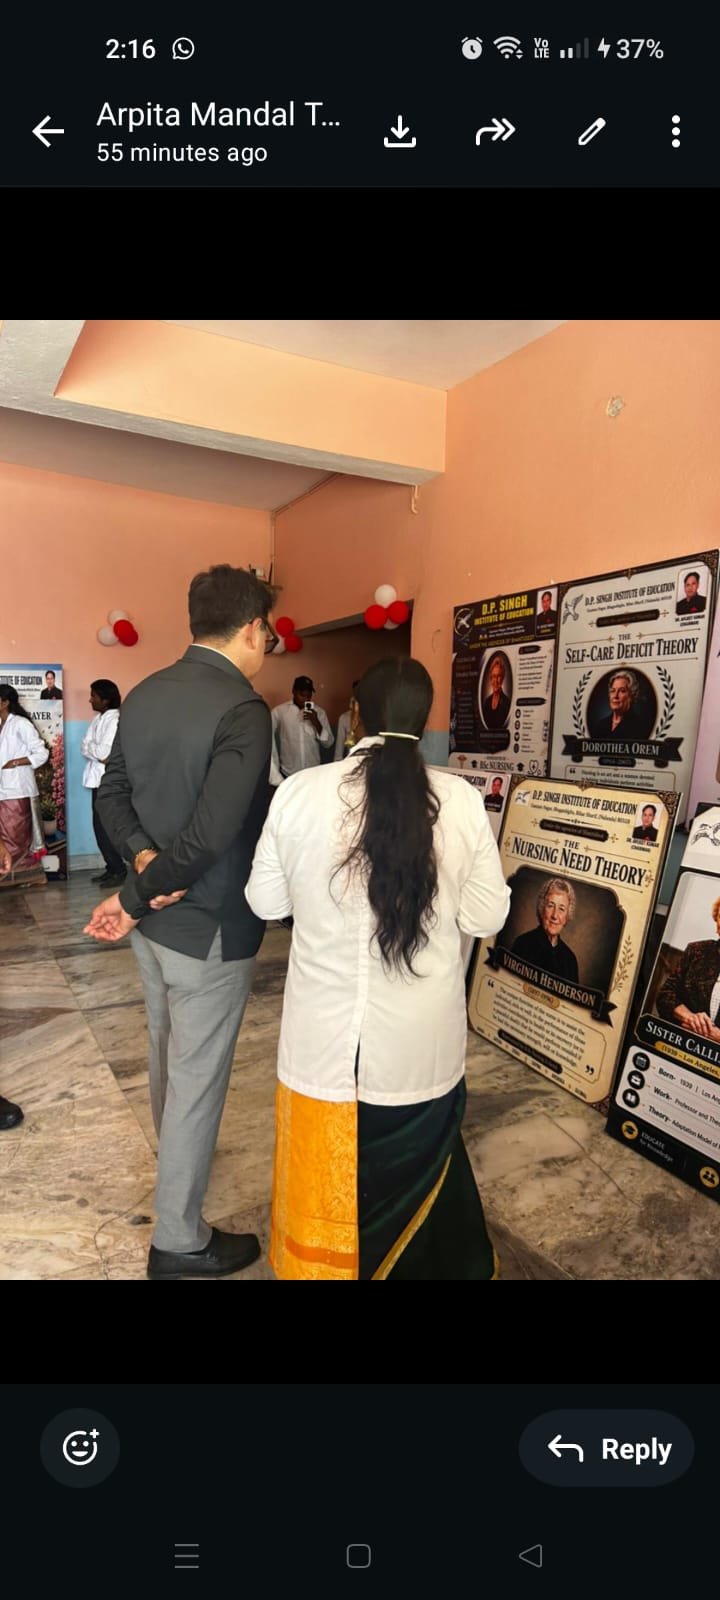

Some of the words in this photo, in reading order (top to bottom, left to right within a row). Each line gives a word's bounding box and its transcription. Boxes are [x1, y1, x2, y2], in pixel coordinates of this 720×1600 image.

[500, 594, 528, 612] SINGH
[613, 588, 638, 601] INSTITUTE
[639, 586, 647, 596] OF
[646, 582, 675, 595] EDUCATION
[618, 633, 631, 641] THE
[565, 645, 615, 664] SELF-CARE
[617, 641, 654, 660] DEFICIT
[656, 637, 699, 656] THEORY
[581, 741, 630, 755] DOROTHEA
[631, 742, 660, 756] OREM
[490, 761, 514, 771] NURSING
[532, 790, 543, 801] D.P.
[543, 791, 560, 804] SINGH
[560, 793, 591, 808] INSTITUTE
[591, 797, 601, 810] OF
[601, 799, 637, 815] EDUCATION
[564, 839, 580, 850] THE
[512, 837, 558, 864] NURSING
[559, 848, 592, 873] NEED
[595, 855, 647, 887] THEORY
[503, 953, 538, 982] VIRGINIA
[540, 972, 597, 1007] HENDERSON
[645, 1020, 682, 1047] SISTER
[683, 1054, 694, 1064] Los
[658, 1067, 676, 1081] Born-
[701, 1089, 711, 1099] Los
[654, 1086, 673, 1101] Work-
[674, 1097, 698, 1115] Professor
[699, 1111, 709, 1121] and
[648, 1105, 671, 1122] Theory-
[672, 1119, 697, 1137] Adaptation
[697, 1133, 713, 1146] Model
